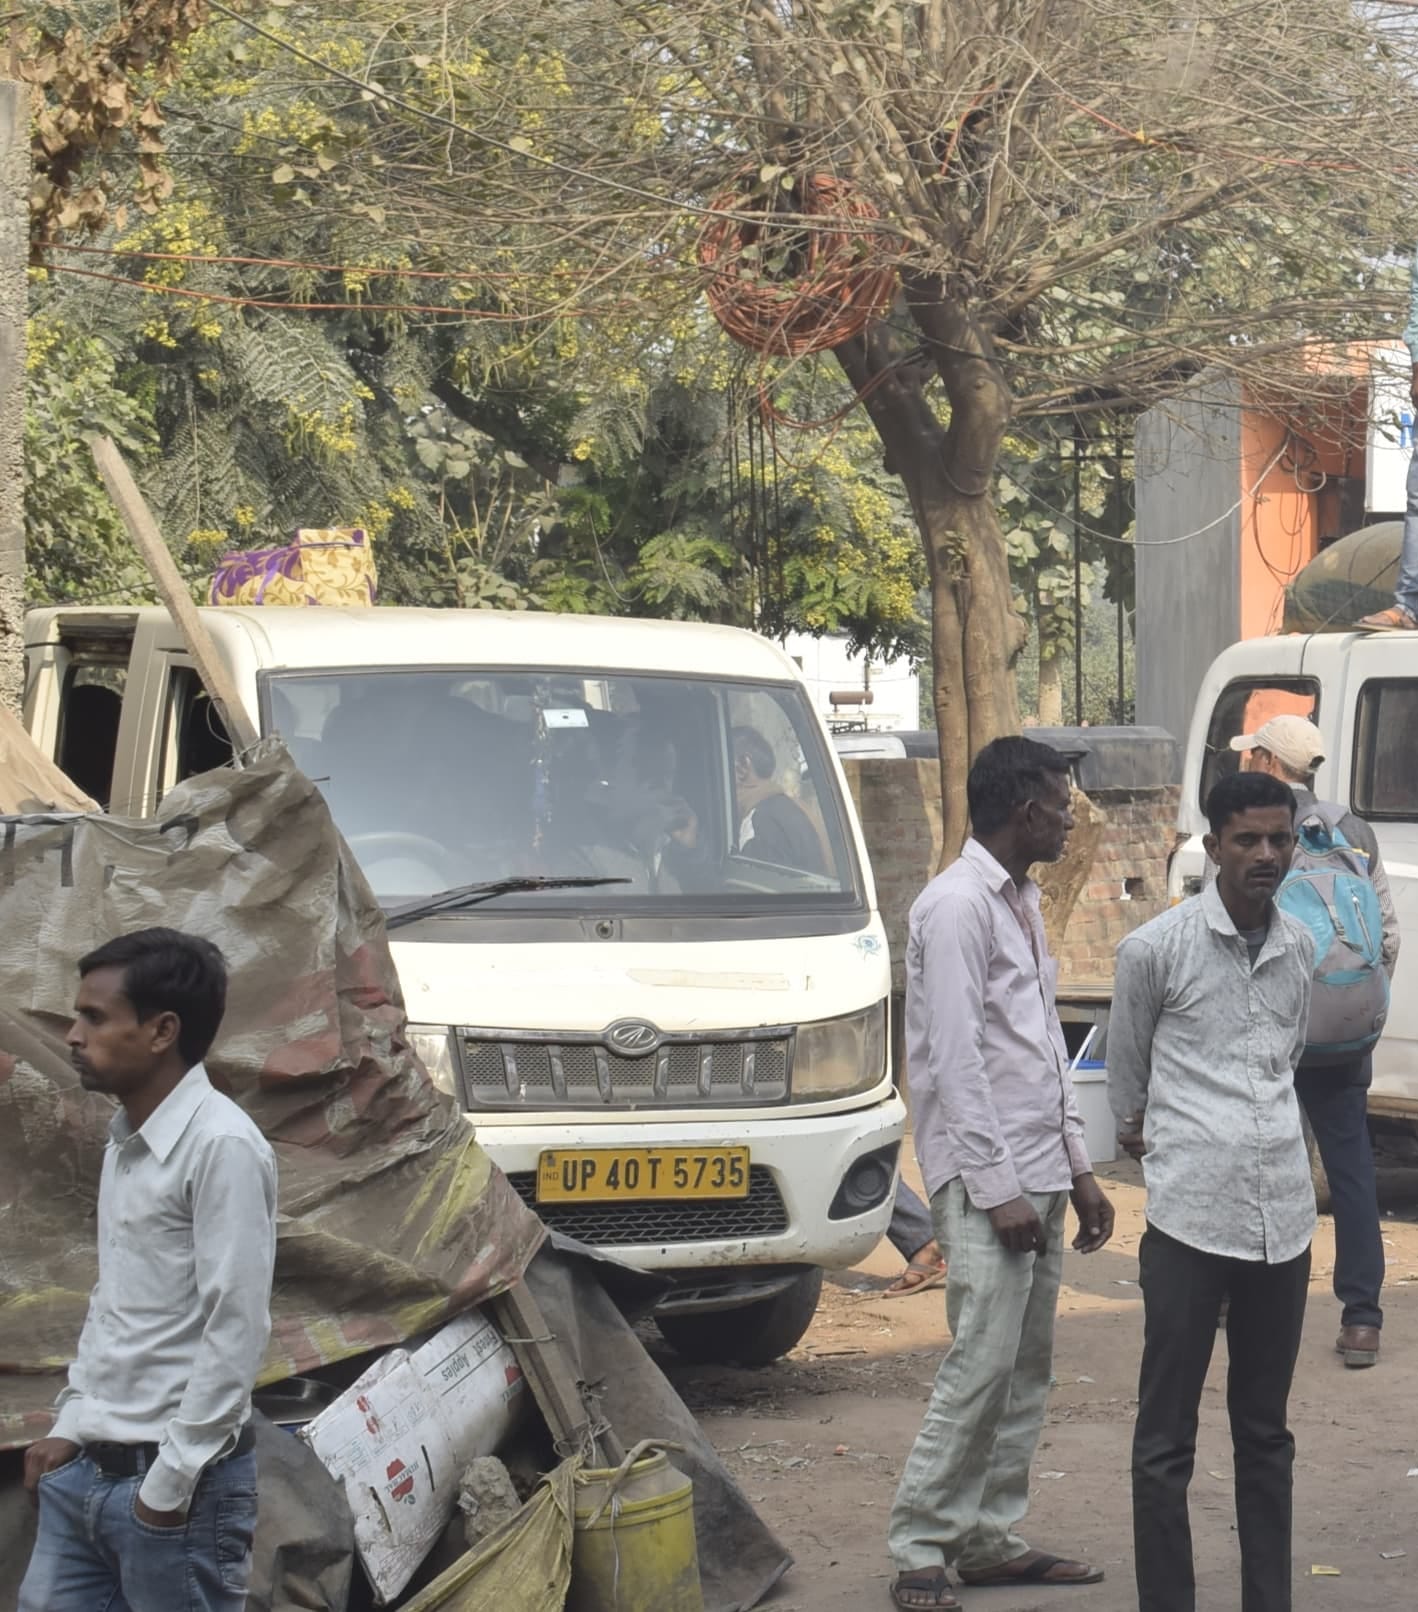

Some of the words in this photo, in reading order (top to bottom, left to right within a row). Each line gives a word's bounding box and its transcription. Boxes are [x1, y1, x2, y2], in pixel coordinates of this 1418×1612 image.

[543, 1172, 558, 1181] IND
[563, 1159, 596, 1191] UP
[606, 1158, 639, 1190] 40
[648, 1158, 662, 1189] T
[674, 1157, 743, 1188] 5735
[472, 1331, 498, 1357] Finest
[441, 1353, 470, 1381] Apples
